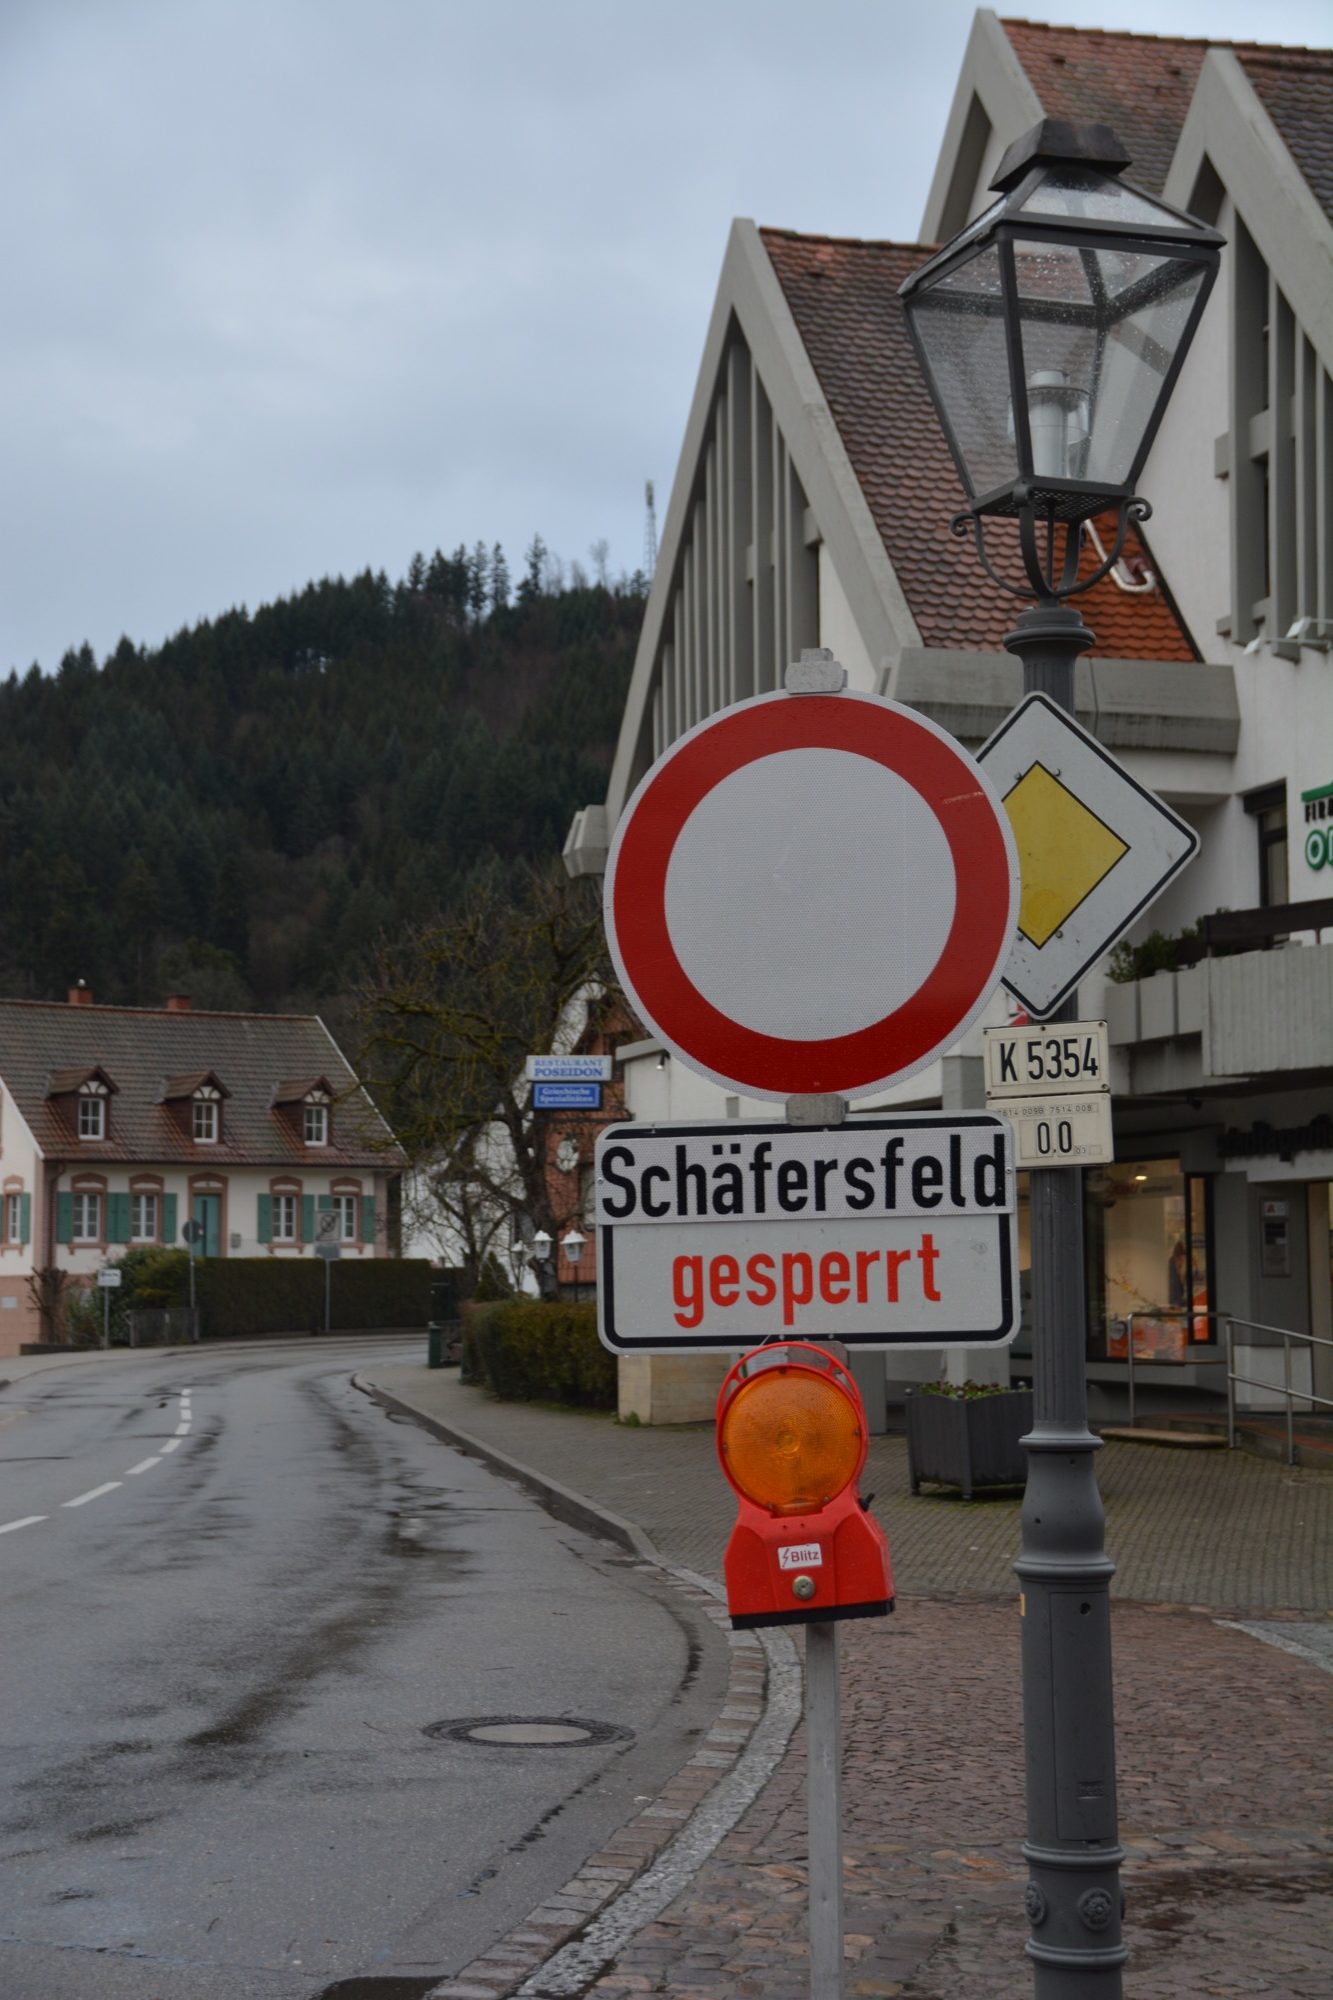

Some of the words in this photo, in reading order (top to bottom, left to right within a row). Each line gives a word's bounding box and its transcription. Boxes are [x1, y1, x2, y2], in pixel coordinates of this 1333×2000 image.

[534, 1067, 603, 1077] POSEIDON
[1000, 1042, 1018, 1082] K
[1027, 1037, 1098, 1080] 5354
[1037, 1121, 1072, 1155] 0.0
[601, 1134, 1006, 1218] Schäfersfeld
[672, 1234, 941, 1328] gesperrt
[791, 1551, 819, 1562] Blitz
